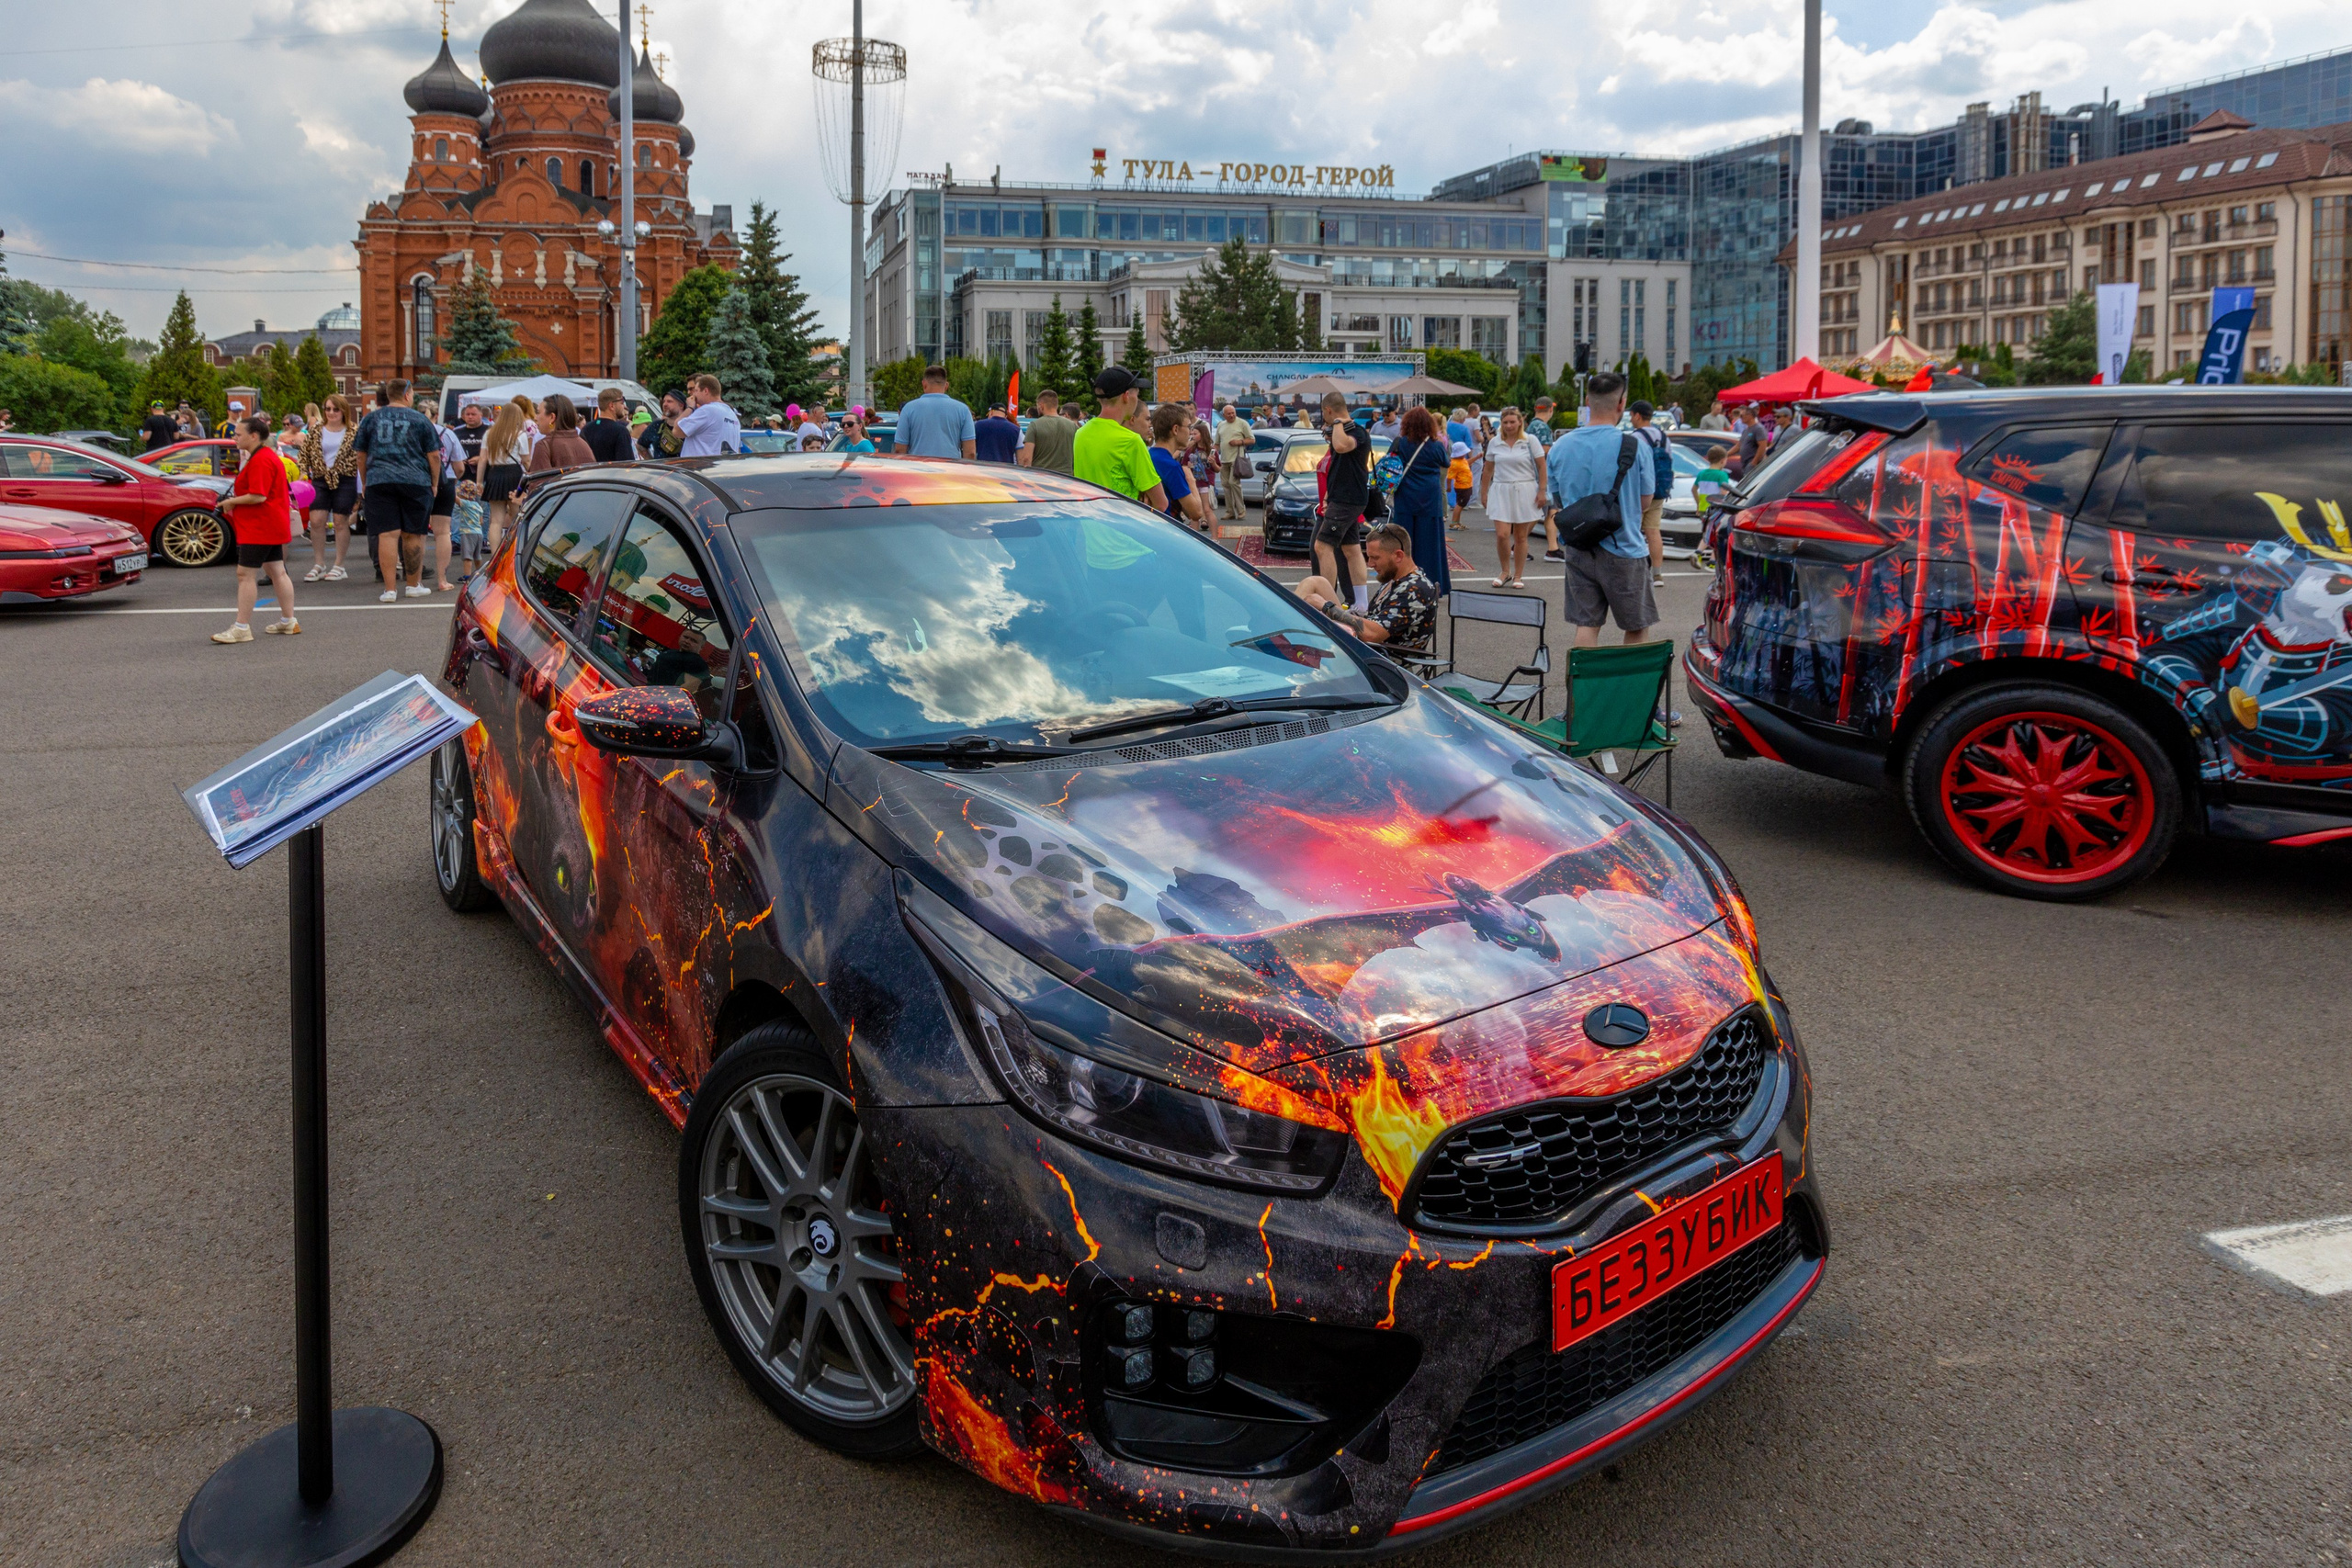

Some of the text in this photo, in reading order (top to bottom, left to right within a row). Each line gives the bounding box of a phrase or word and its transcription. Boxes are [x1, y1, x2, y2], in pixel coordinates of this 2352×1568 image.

[906, 172, 948, 180] МАГАДАН
[1123, 159, 1194, 180] ТУЛА
[1220, 163, 1396, 187] ГОРОД-ГЕРОЙ
[377, 419, 411, 445] 07
[1990, 469, 2029, 494] EMPIRE
[1570, 1168, 1772, 1330] БЕЗЗУБИК
